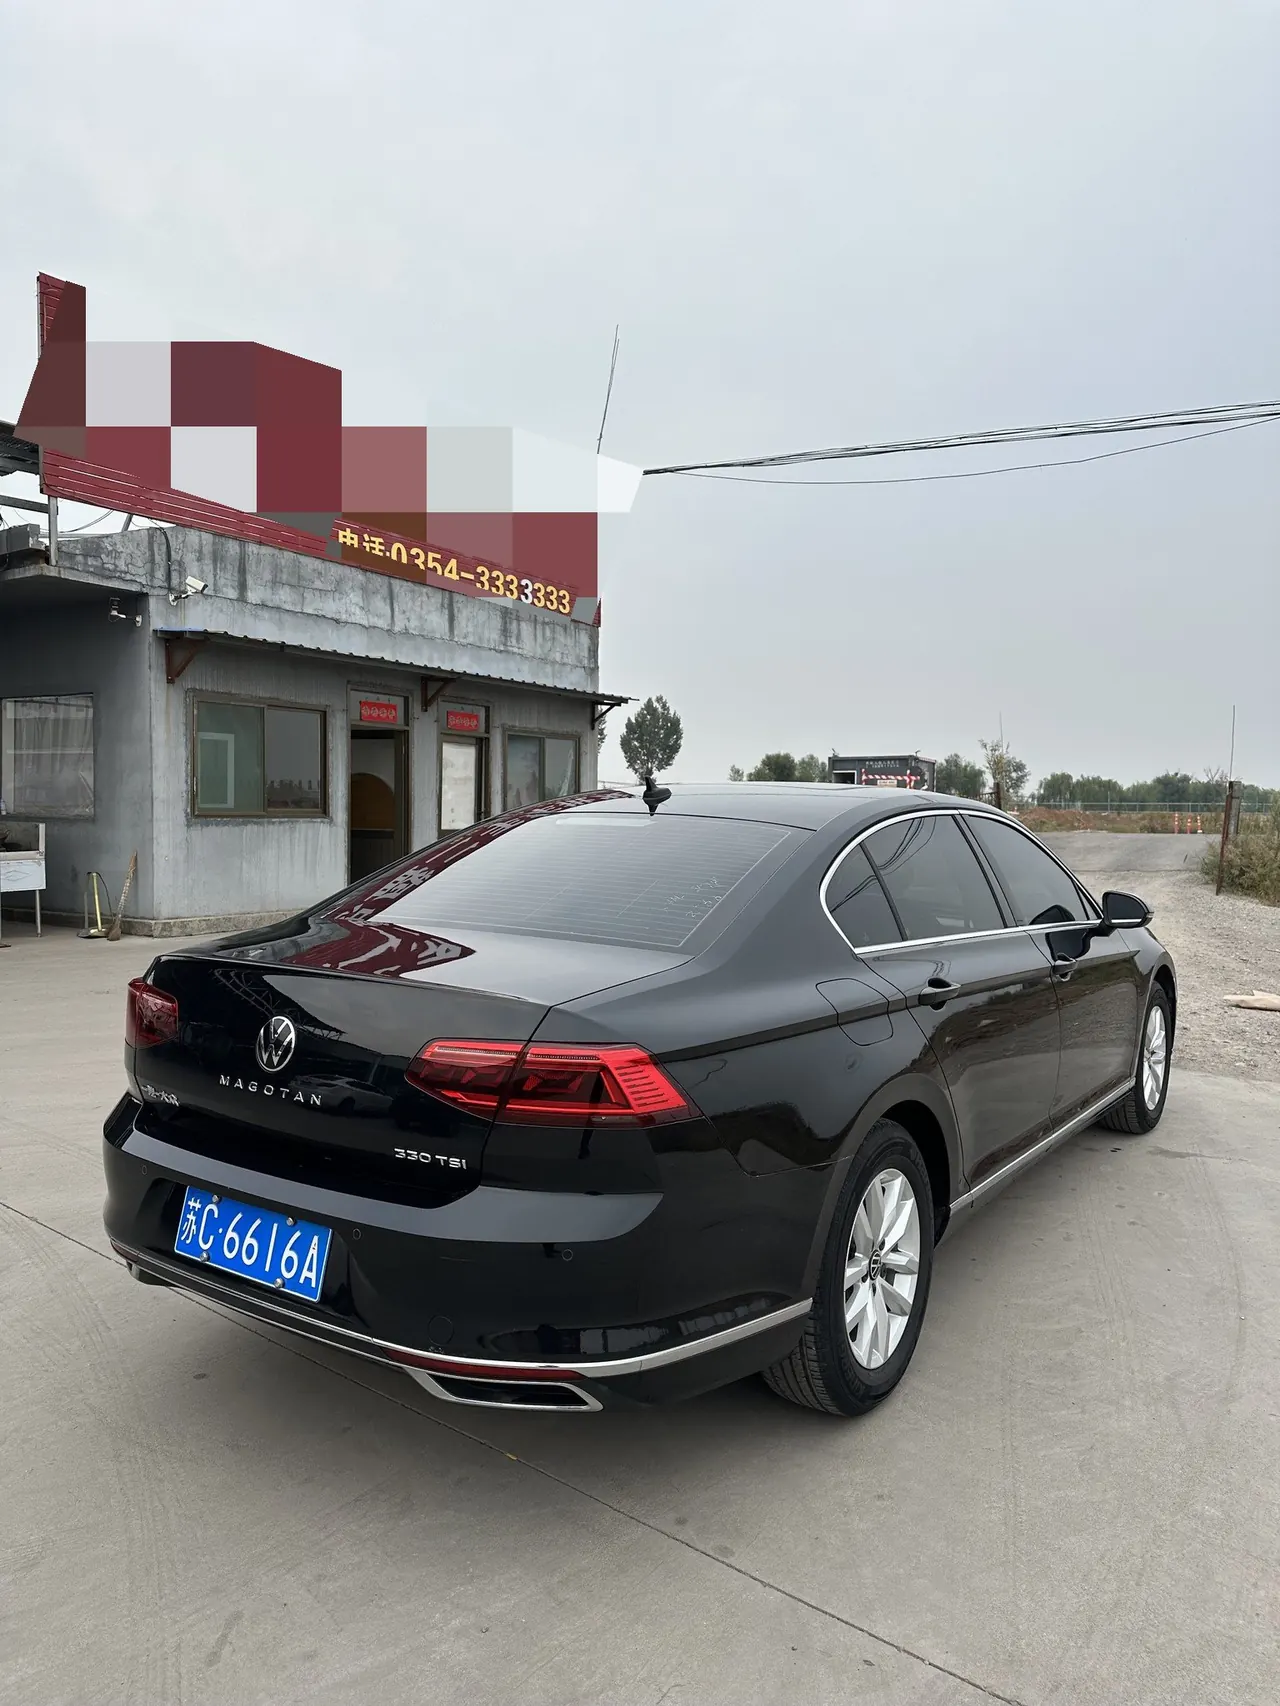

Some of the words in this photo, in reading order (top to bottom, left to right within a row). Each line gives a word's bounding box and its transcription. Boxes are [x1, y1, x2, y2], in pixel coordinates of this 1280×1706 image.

[219, 1074, 322, 1106] MAGOTAN
[394, 1147, 432, 1163] 330
[434, 1154, 468, 1170] TSI
